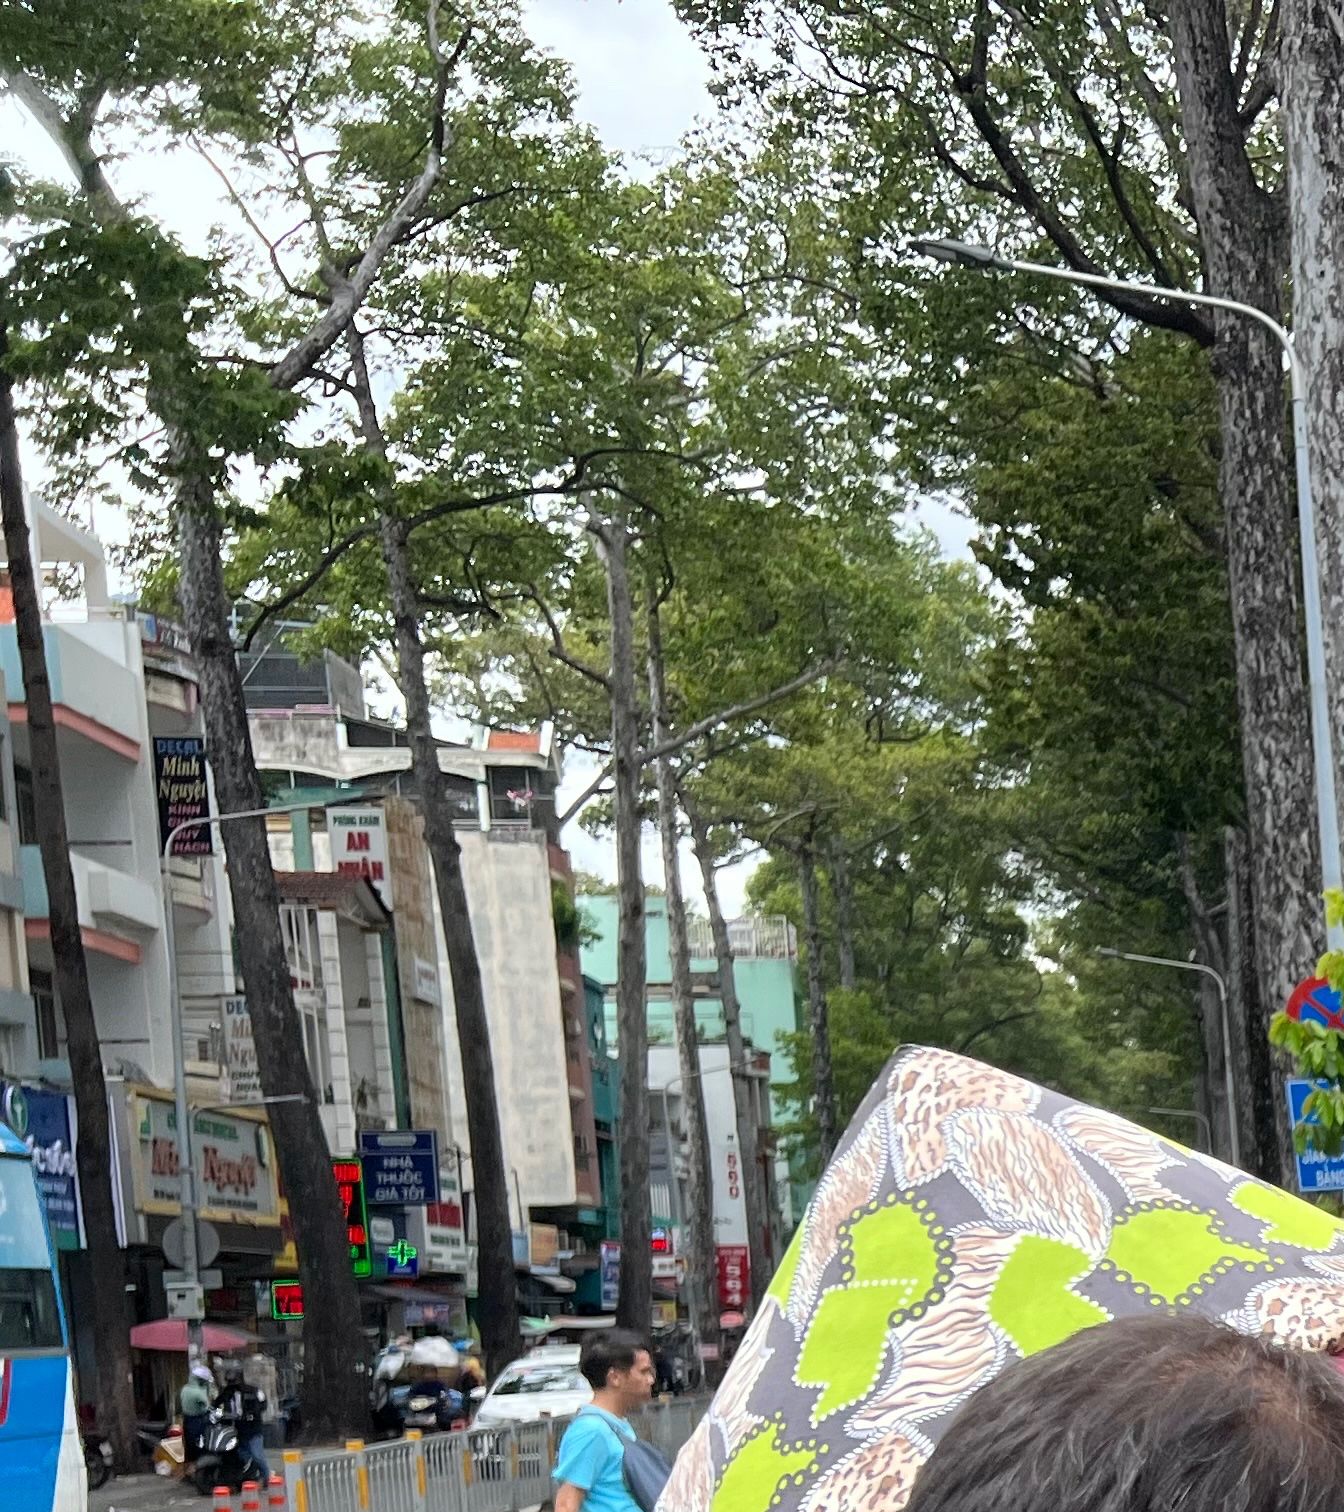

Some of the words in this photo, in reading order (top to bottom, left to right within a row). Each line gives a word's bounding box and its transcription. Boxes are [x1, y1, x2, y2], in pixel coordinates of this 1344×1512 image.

[347, 832, 370, 851] AN
[384, 1155, 413, 1169] NHÀ
[376, 1169, 423, 1185] THUỐC
